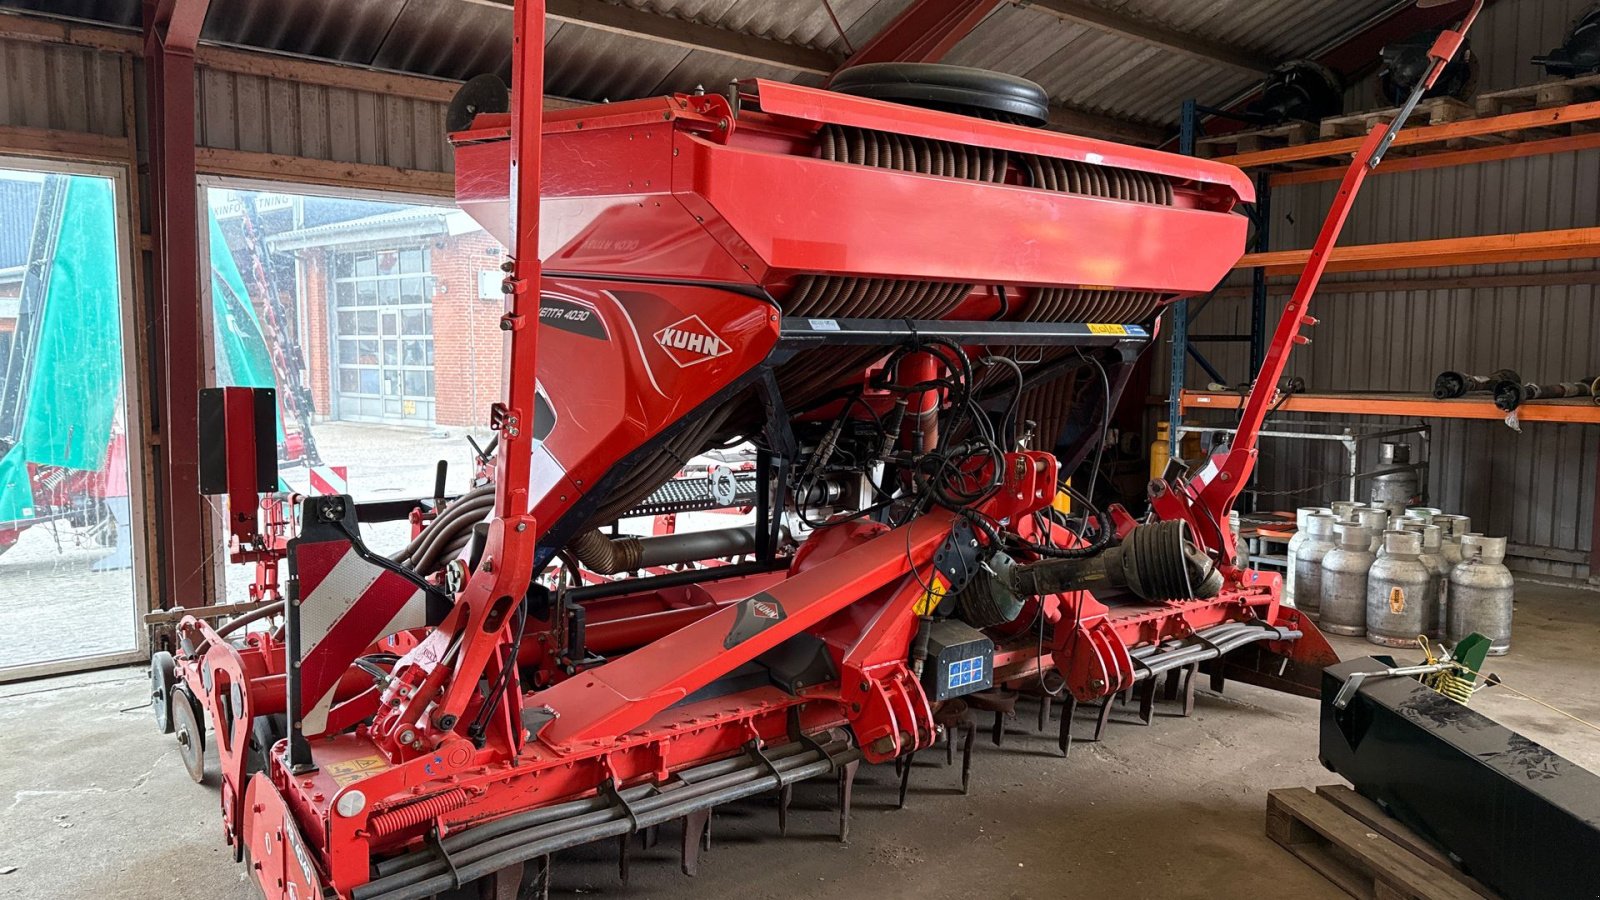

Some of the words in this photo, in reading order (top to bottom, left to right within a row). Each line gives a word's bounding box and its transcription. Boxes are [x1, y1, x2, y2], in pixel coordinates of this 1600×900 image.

[539, 307, 565, 319] ENTA
[564, 310, 590, 321] 4030
[661, 328, 720, 356] KUHN
[753, 602, 778, 618] KUHN
